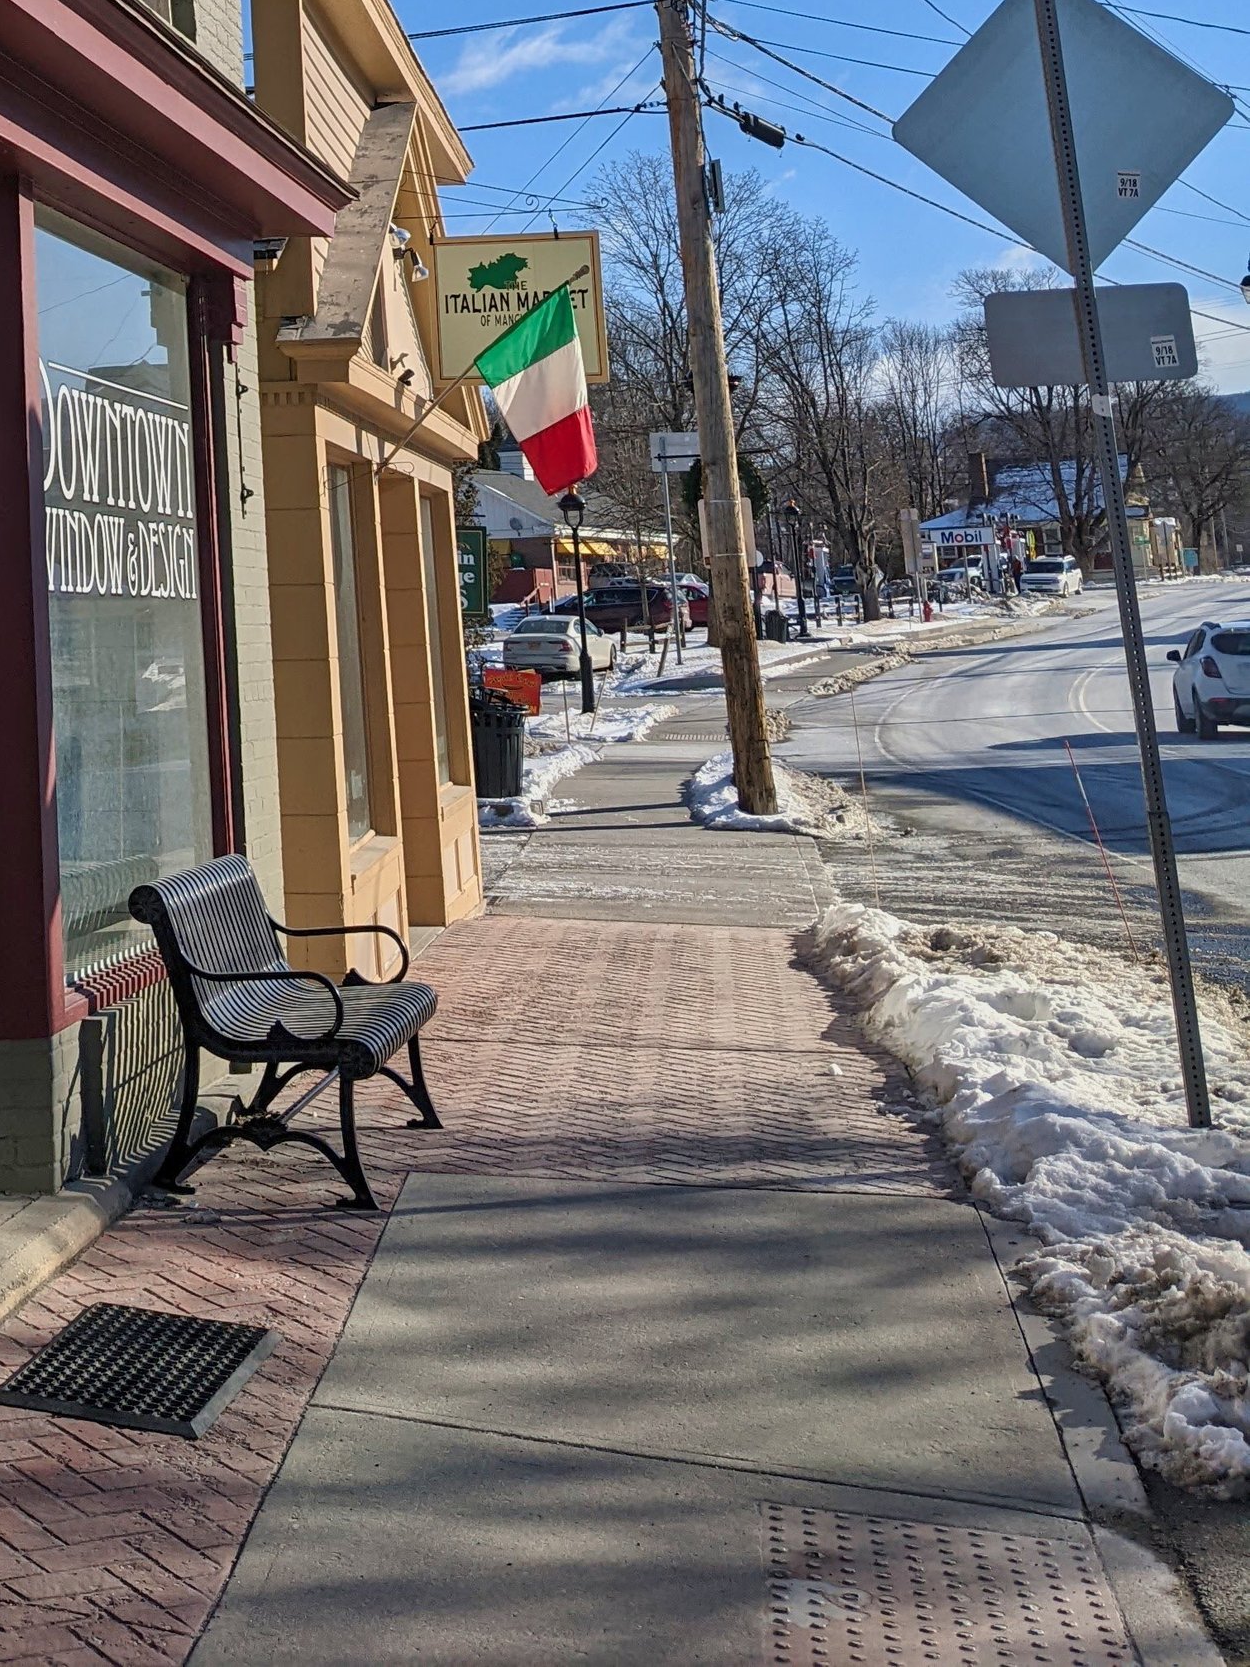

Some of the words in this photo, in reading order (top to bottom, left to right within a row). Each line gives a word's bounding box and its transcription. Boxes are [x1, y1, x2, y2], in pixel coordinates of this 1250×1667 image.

[1120, 177, 1138, 187] 9/18
[1118, 187, 1128, 197] VT
[1129, 188, 1139, 198] 7A
[504, 280, 528, 291] THE
[444, 292, 511, 314] ITALIAN
[516, 288, 589, 314] MAET
[480, 314, 491, 327] OF
[1155, 345, 1174, 356] 9/18
[1155, 355, 1165, 366] VT
[1166, 354, 1177, 365] 7A
[940, 530, 983, 544] Mobil
[127, 532, 138, 597] &
[137, 520, 198, 600] DESIGN
